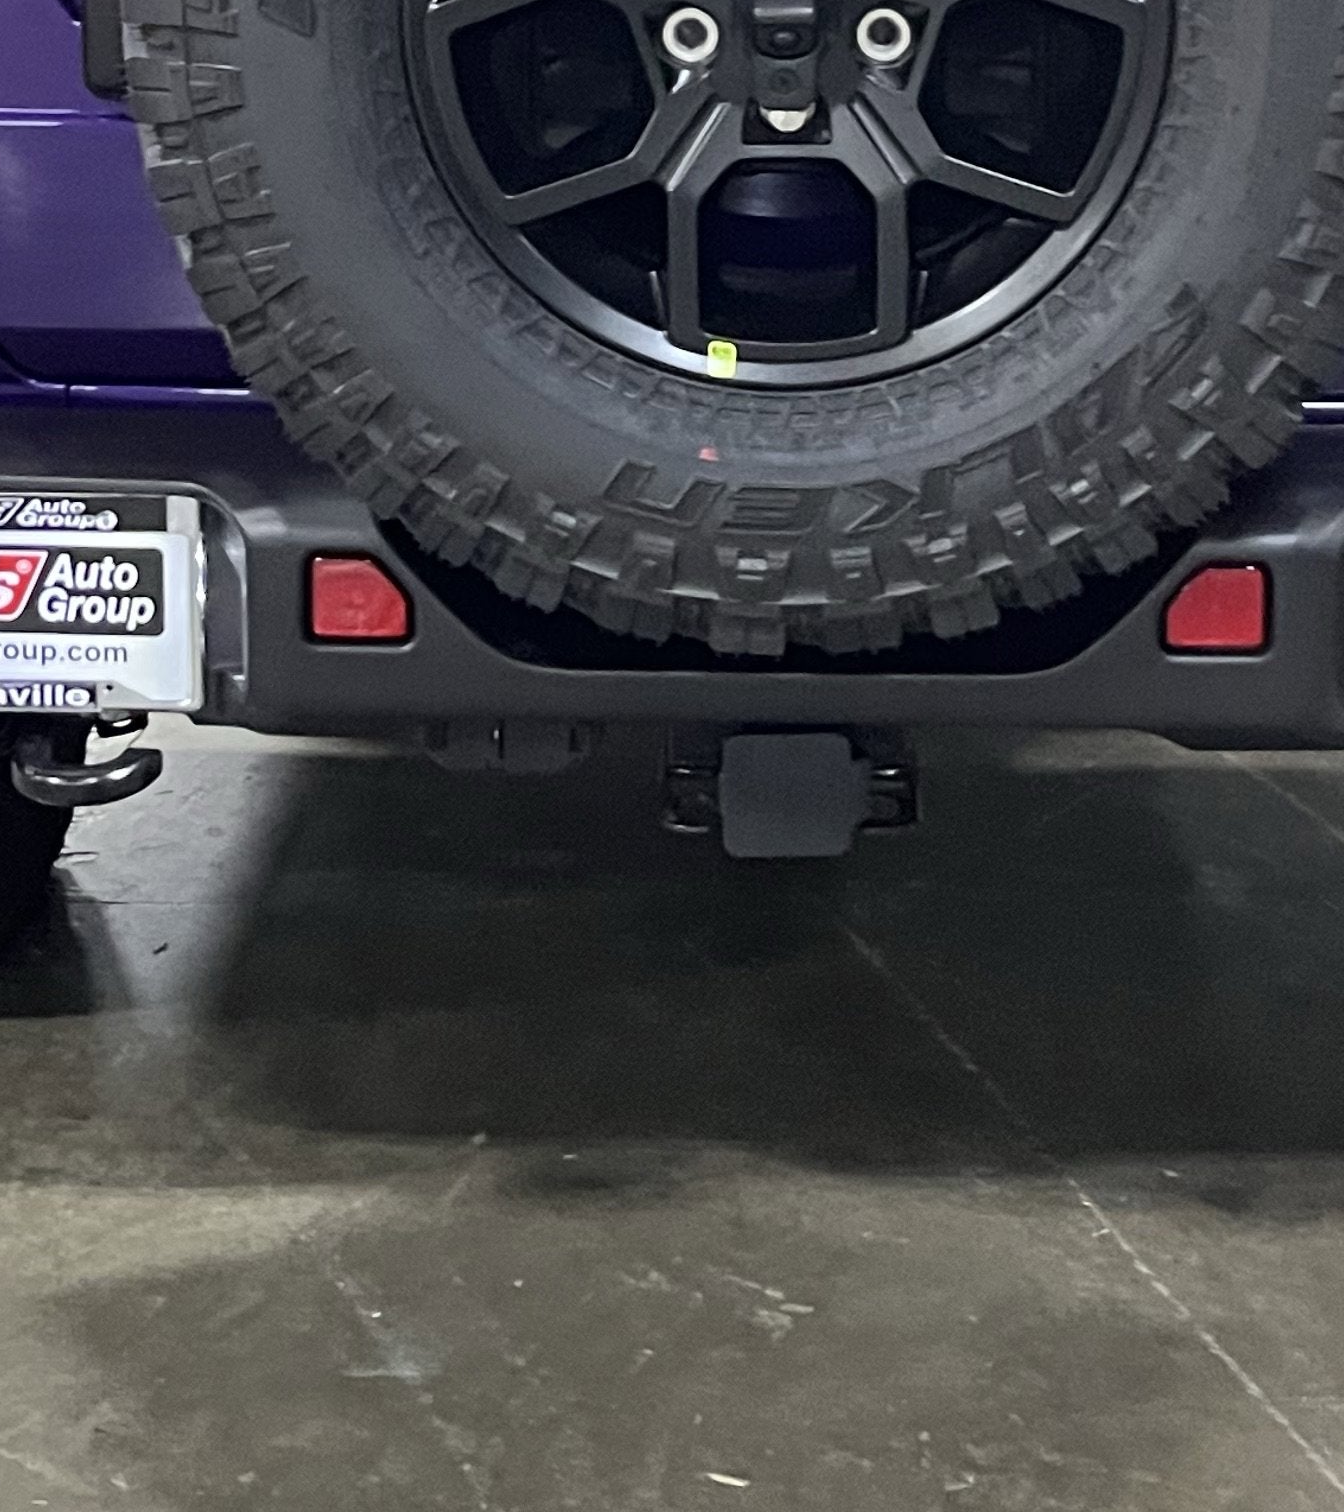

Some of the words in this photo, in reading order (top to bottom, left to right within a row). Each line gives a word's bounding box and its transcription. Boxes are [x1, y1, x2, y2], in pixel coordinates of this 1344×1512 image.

[16, 510, 96, 531] Group
[25, 498, 87, 515] Auto
[44, 552, 140, 591] Auto
[37, 587, 156, 632] Group
